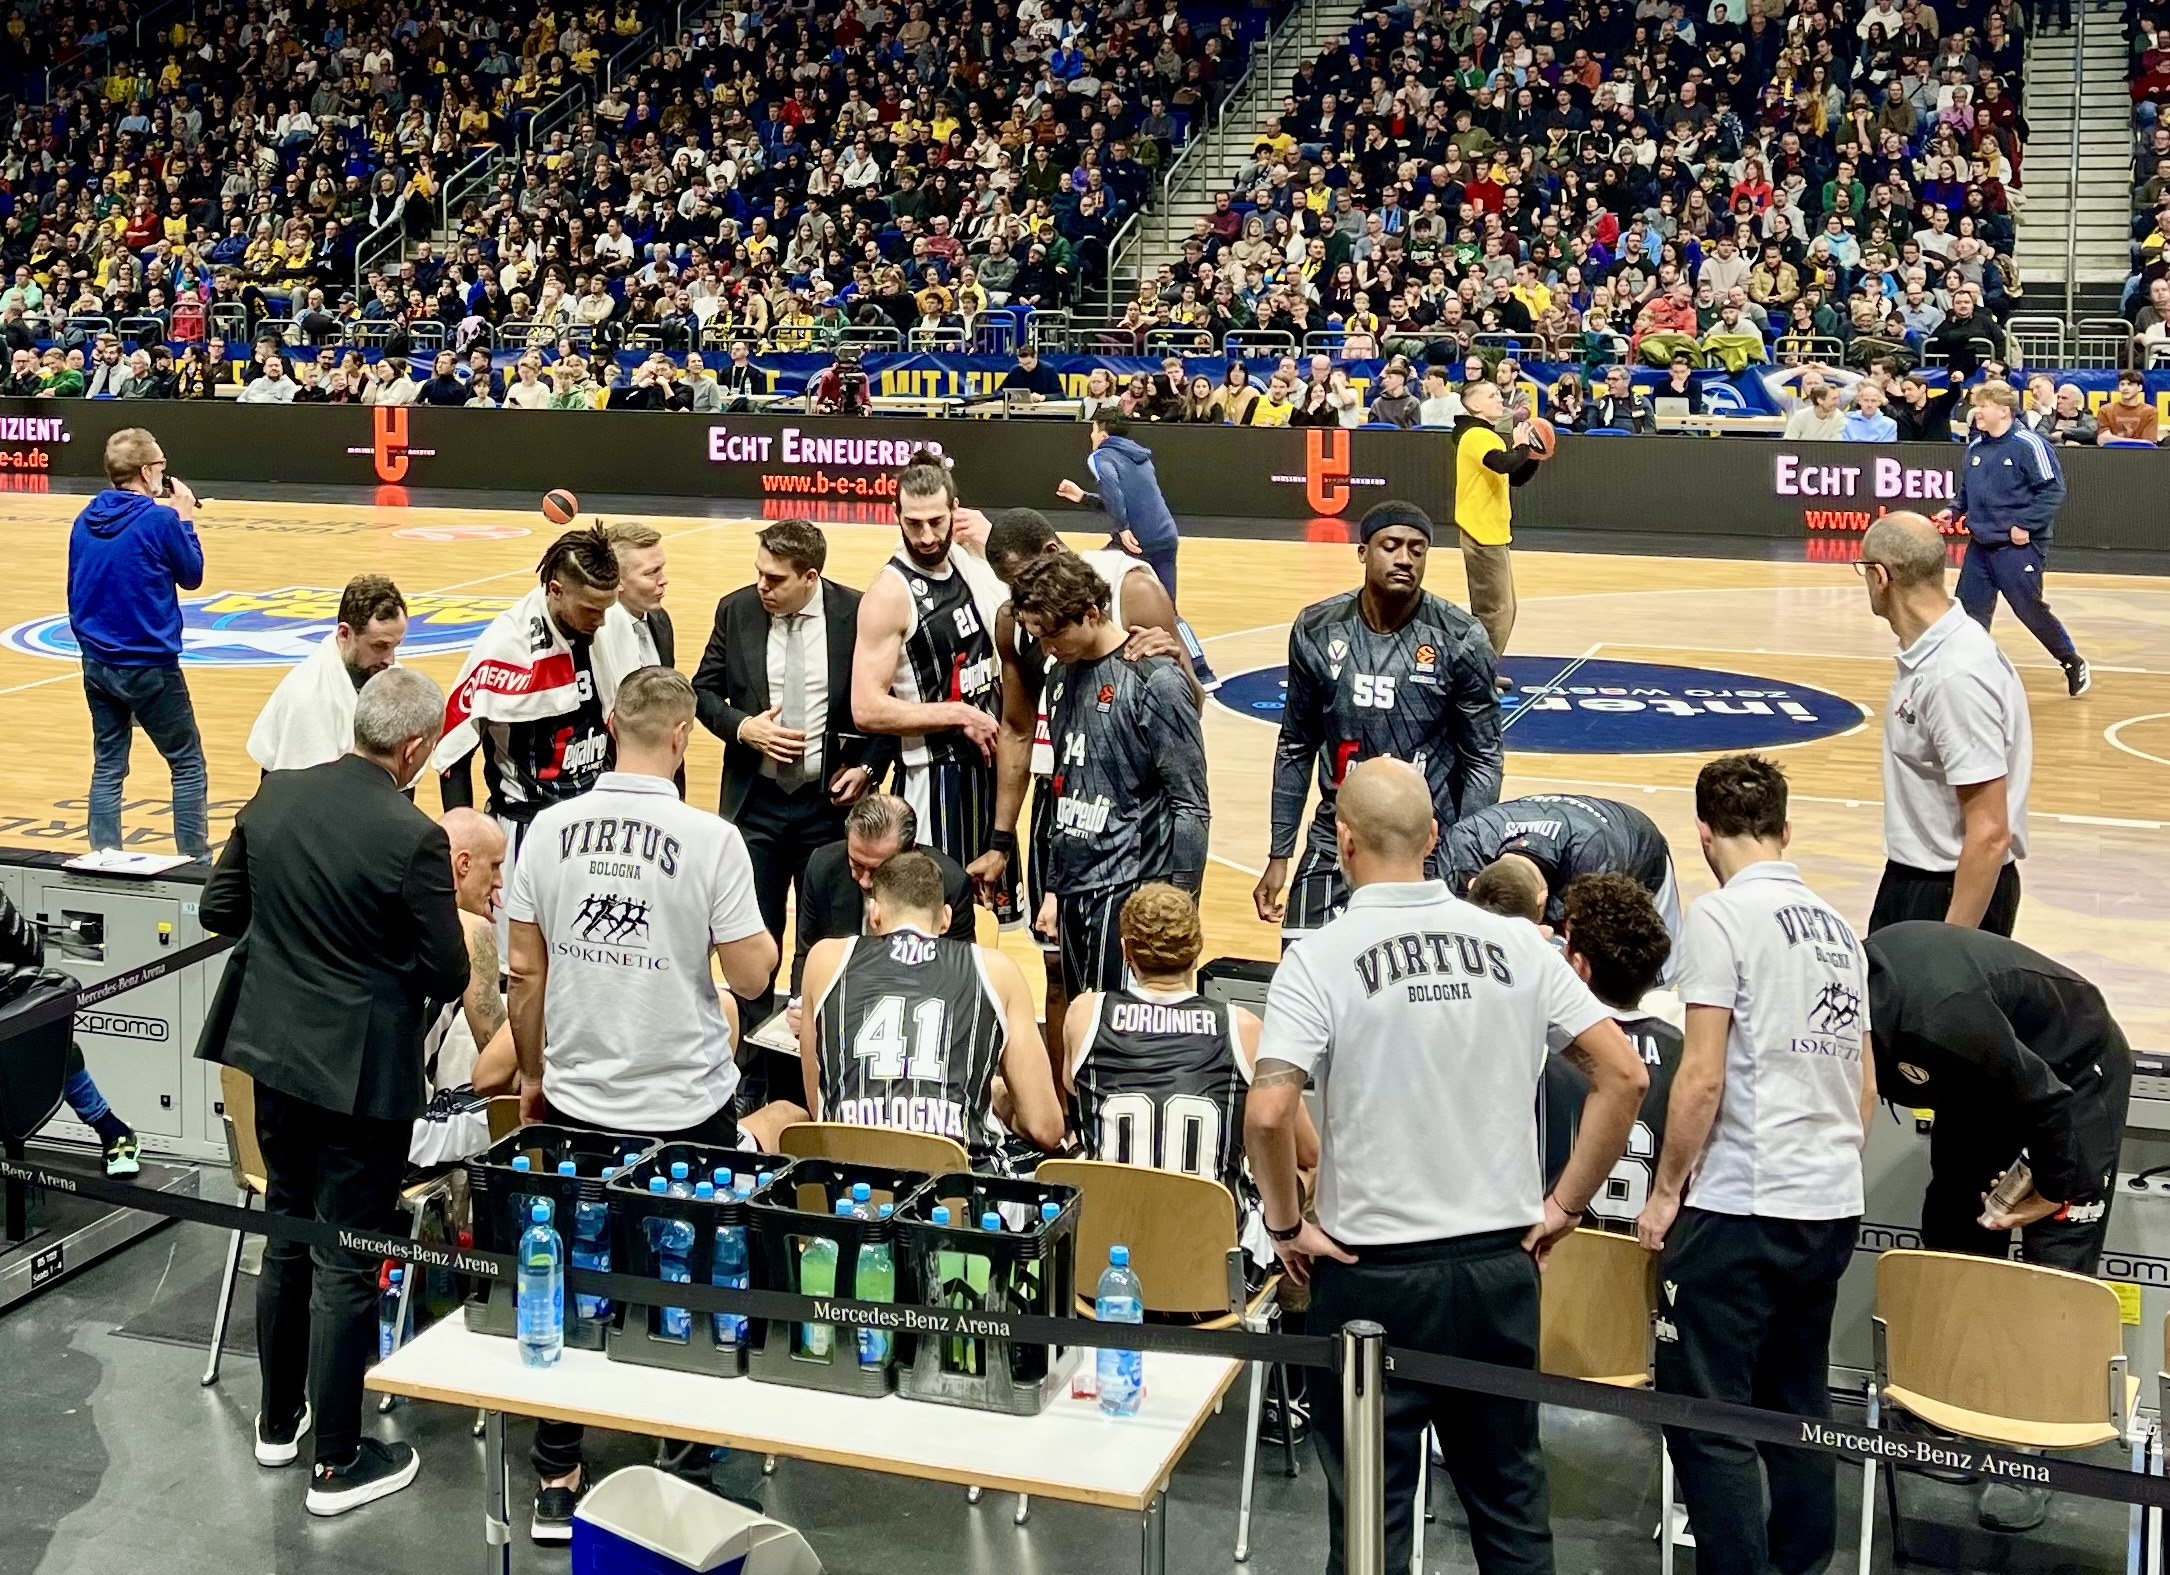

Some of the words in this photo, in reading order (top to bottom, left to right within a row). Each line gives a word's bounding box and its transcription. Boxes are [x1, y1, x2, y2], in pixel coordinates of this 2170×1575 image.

[881, 370, 942, 408] MIT
[762, 470, 898, 496] www.b-e-a.de
[952, 603, 980, 639] 21
[1352, 672, 1396, 710] 55
[1063, 731, 1086, 767] 14
[559, 816, 683, 880] VIRTUS
[589, 859, 642, 881] BOLOGNA
[550, 941, 671, 972] ISOKINETIC
[1353, 930, 1515, 999] VIRTUS
[76, 972, 140, 1006] Mercedes-Benz
[1408, 982, 1473, 1003] BOLOGNA
[1111, 1003, 1218, 1037] CORDINIER
[853, 995, 947, 1083] 41
[840, 1096, 964, 1138] BOLOGNA
[1099, 1092, 1222, 1181] 00
[37, 1170, 76, 1192] Arena
[338, 1231, 450, 1267] Mercedes-Benz
[453, 1251, 499, 1275] Arena
[813, 1301, 950, 1334] Mercedes-Benz
[954, 1314, 1011, 1337] Arena
[1800, 1422, 1972, 1470] Mercedes-Benz
[1978, 1456, 2051, 1483] Arena
